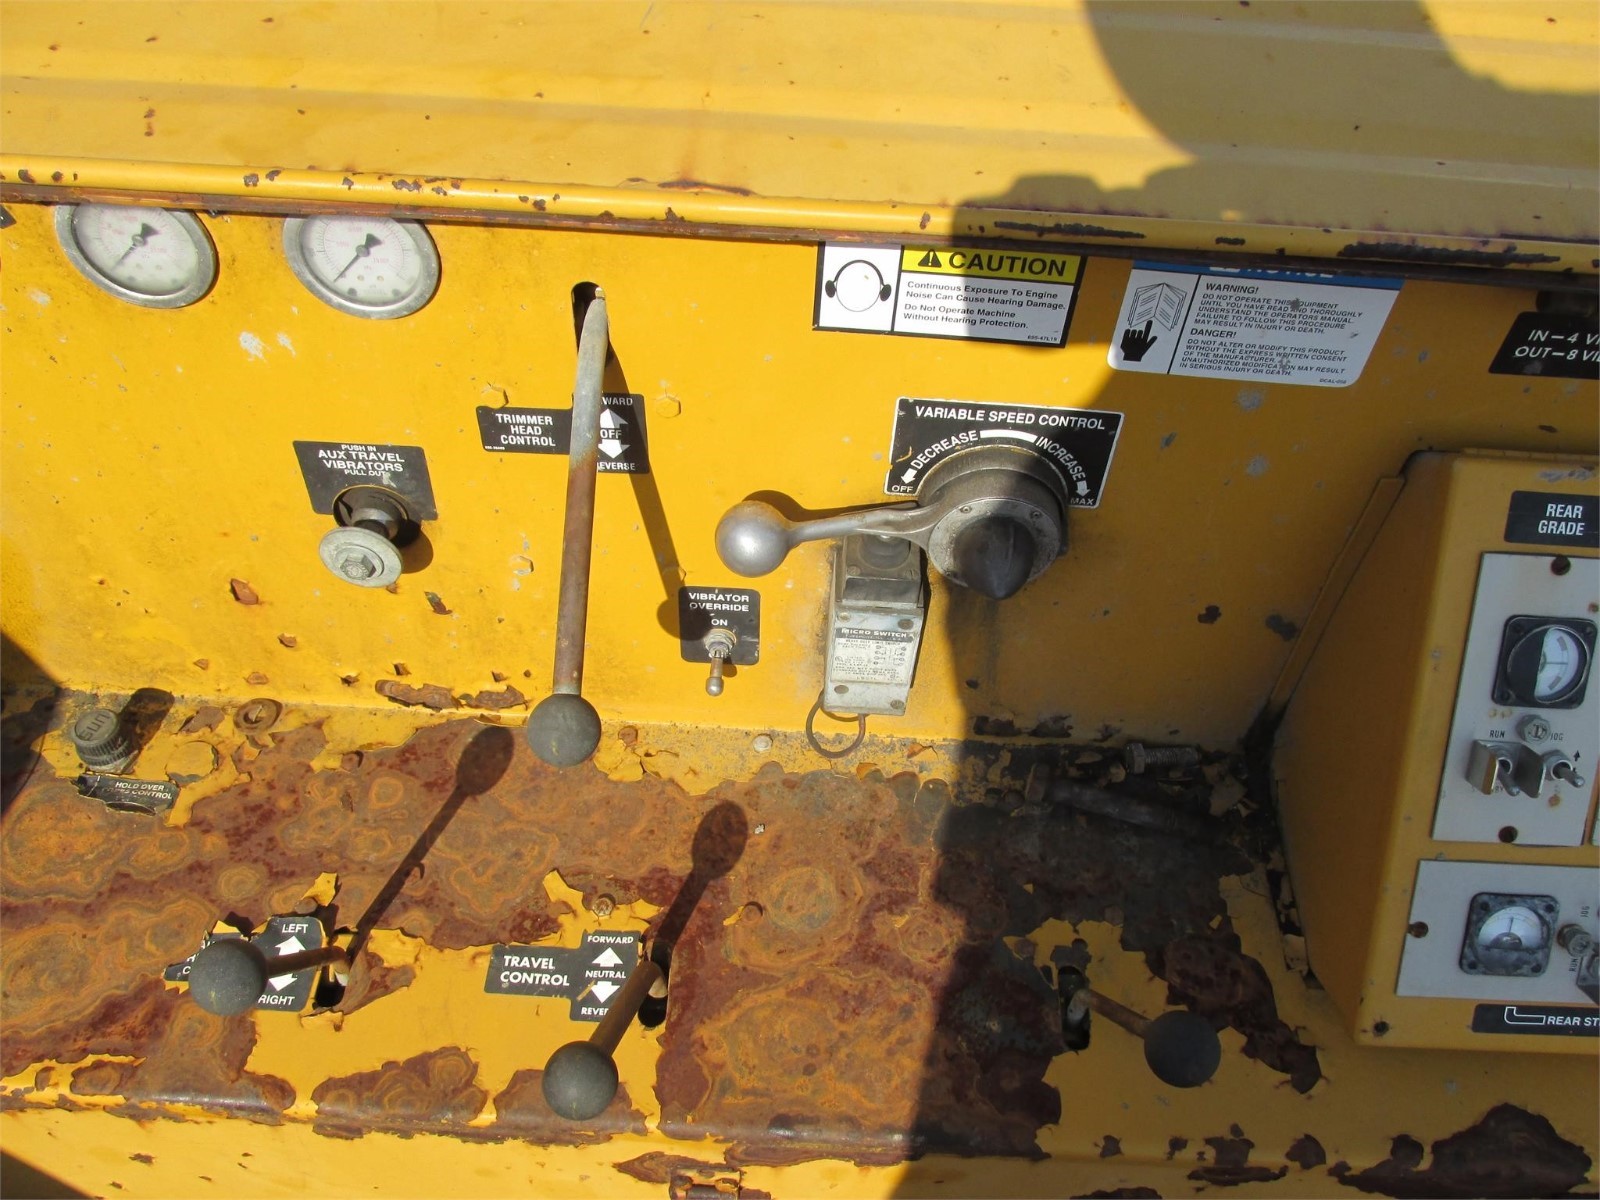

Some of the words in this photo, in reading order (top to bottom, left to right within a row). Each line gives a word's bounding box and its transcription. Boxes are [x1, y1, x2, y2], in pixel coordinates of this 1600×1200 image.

[949, 252, 1066, 277] CAUTION
[907, 281, 961, 291] Continuous
[964, 285, 1008, 295] Exposure
[1011, 288, 1023, 296] To
[1025, 290, 1058, 300] Engine
[1206, 283, 1259, 294] WARNING!
[906, 290, 932, 299] Noise
[956, 294, 985, 303] Cause
[987, 297, 1023, 307] Hearing
[1026, 300, 1065, 310] Damage.
[1235, 296, 1272, 304] OPERATE
[1292, 299, 1339, 309] QUIPMENT
[920, 304, 936, 312] Not
[938, 306, 974, 315] Operate
[977, 309, 1015, 318] Machine
[1198, 306, 1251, 315] UNDERSTAND
[1271, 312, 1319, 320] OPERATORS
[1309, 308, 1363, 317] THOROUGHLY
[903, 313, 938, 321] Without
[941, 316, 976, 325] Hearing
[979, 318, 1028, 328] Protection.
[1196, 312, 1229, 320] FAILURE
[1297, 320, 1346, 329] PROCEDURE
[1213, 320, 1243, 328] RESULT
[1190, 328, 1237, 338] DANGER!
[1308, 347, 1345, 355] PRODUCT
[1311, 354, 1347, 362] CONSENT
[1182, 357, 1240, 366] UNAUTHORIZED
[1242, 361, 1295, 370] MODIFICAON
[1315, 366, 1345, 374] RESULT
[1189, 363, 1222, 371] SERIOUS
[601, 396, 633, 406] WARD
[496, 413, 553, 425] TRIMMER
[915, 406, 984, 421] VARIABLE
[988, 411, 1035, 424] SPEED
[1038, 414, 1105, 430] CONTROL
[510, 425, 542, 436] HEAD
[600, 429, 622, 439] OFF
[500, 434, 556, 447] CONTROL
[910, 430, 978, 470] DECREASE
[318, 450, 347, 459] AUX
[349, 451, 405, 462] TRAVEL
[1035, 436, 1085, 481] INCREASE
[323, 459, 403, 472] VIBRATORS
[597, 461, 636, 471] EVERSE
[892, 484, 914, 493] OFF
[1070, 497, 1095, 506] MAX
[1546, 503, 1583, 519] REAR
[1538, 520, 1585, 536] GRADE
[688, 592, 749, 602] VIBRATOR
[689, 602, 749, 612] OVERRIDE
[711, 618, 728, 626] ON
[841, 627, 871, 635] MICRO
[873, 630, 907, 638] SWITCH
[1489, 730, 1505, 738] RUN
[1550, 732, 1564, 741] JOG
[131, 789, 173, 799] CONTROL
[281, 923, 308, 934] LEFT
[587, 935, 634, 944] FORWARD
[503, 955, 556, 970] TRAVEL
[1568, 958, 1579, 972] RUN
[500, 971, 570, 986] CONTROL
[585, 970, 627, 979] NEUTRAL
[258, 994, 295, 1005] RIGHT
[1547, 1016, 1581, 1026] REAR
[1584, 1017, 1600, 1027] ST
